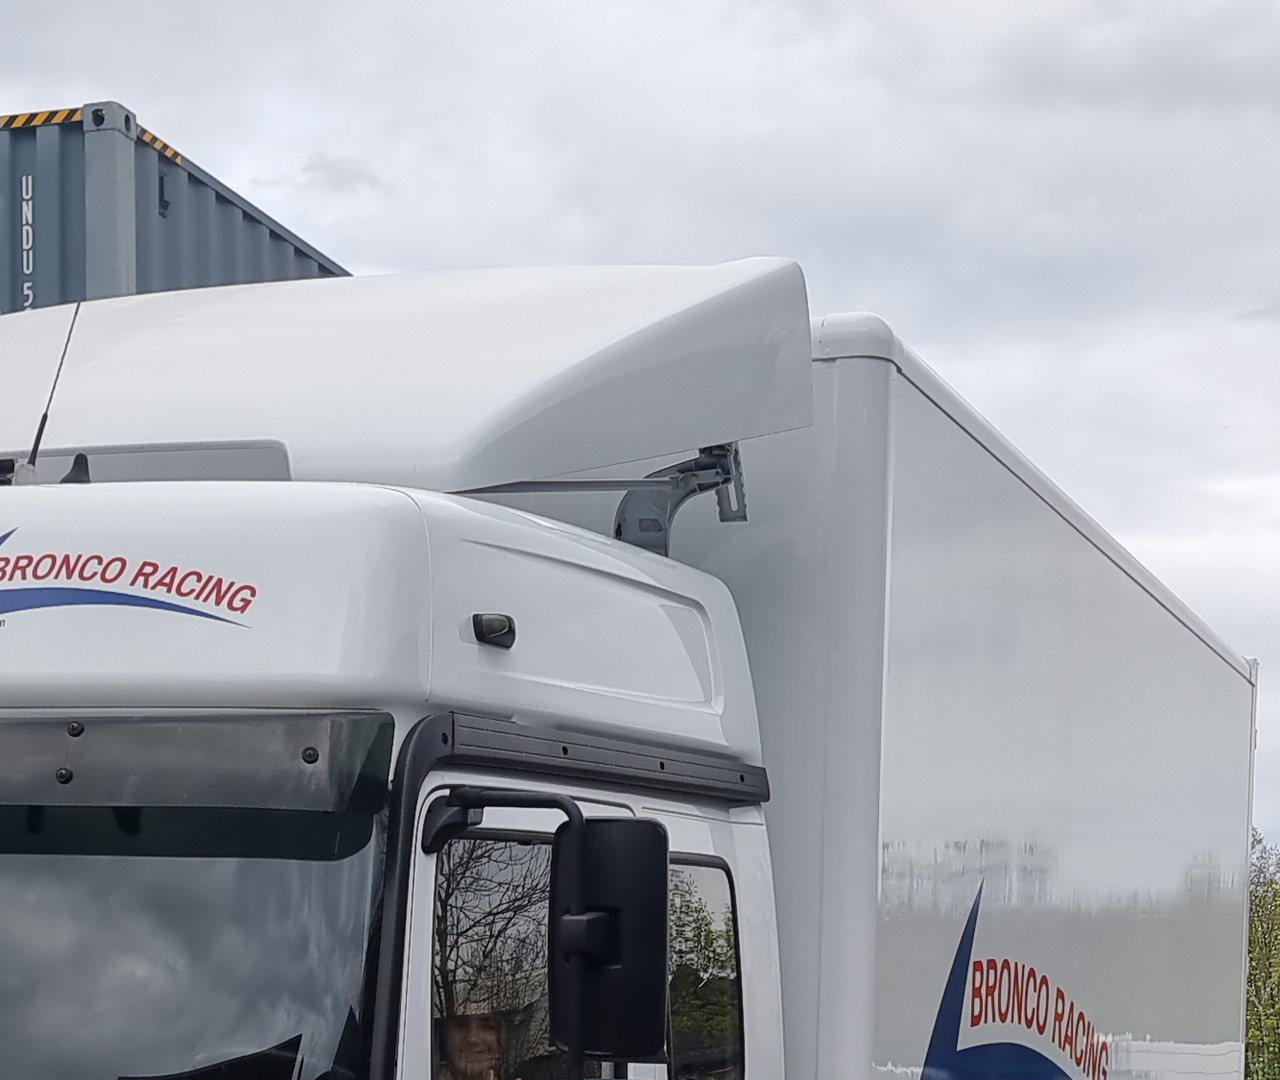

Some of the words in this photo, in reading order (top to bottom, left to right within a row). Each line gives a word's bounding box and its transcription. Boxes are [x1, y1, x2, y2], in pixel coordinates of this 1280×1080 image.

[22, 175, 33, 274] UNDU
[129, 561, 257, 614] RACING
[970, 958, 1049, 1035] BRONCO
